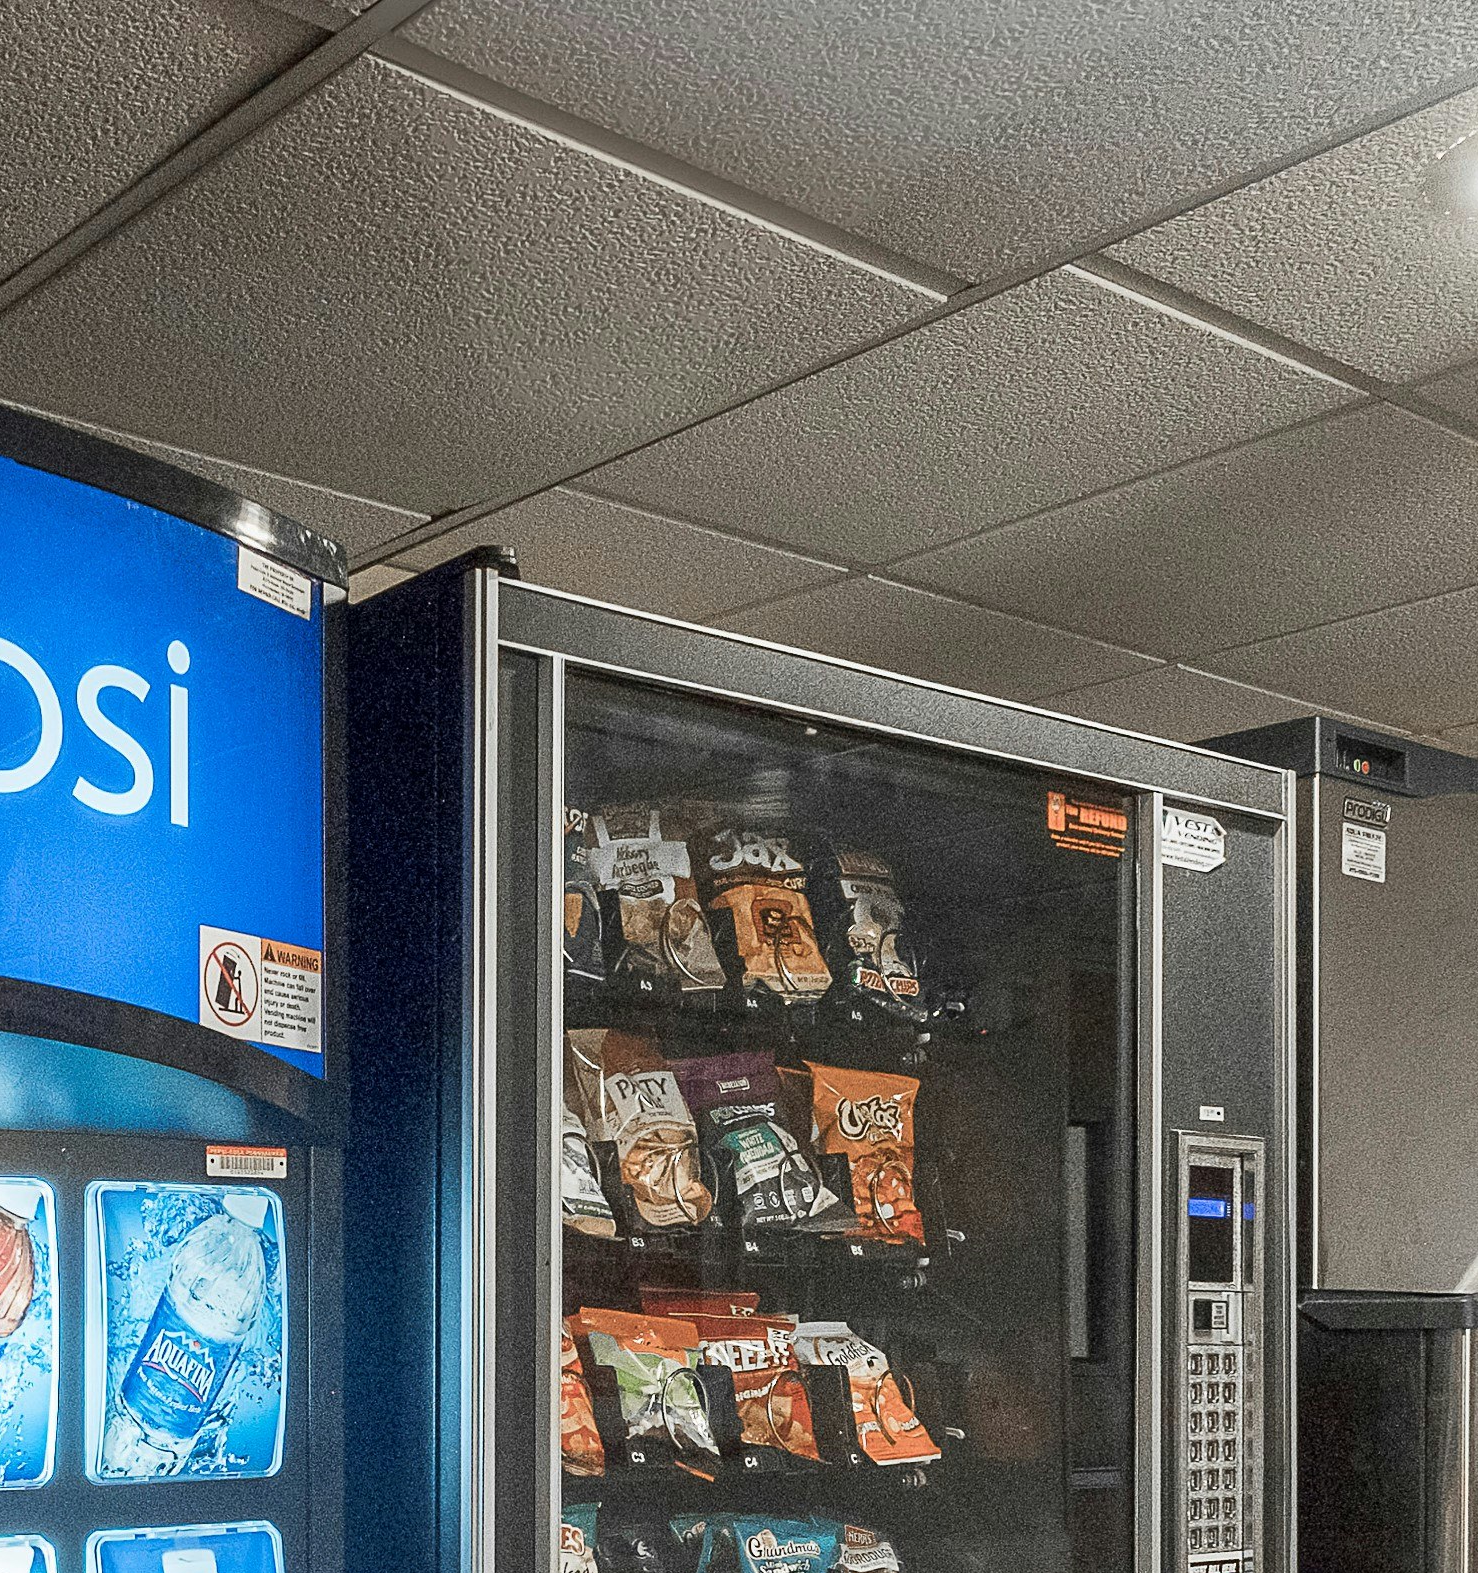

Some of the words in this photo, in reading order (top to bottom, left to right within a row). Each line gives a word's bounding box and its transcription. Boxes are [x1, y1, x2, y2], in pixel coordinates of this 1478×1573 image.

[277, 950, 319, 972] WARNING
[631, 1237, 645, 1247] B3
[745, 1241, 760, 1252] B4
[826, 1342, 874, 1366] Goldfish
[142, 1329, 216, 1403] AQUAFINA
